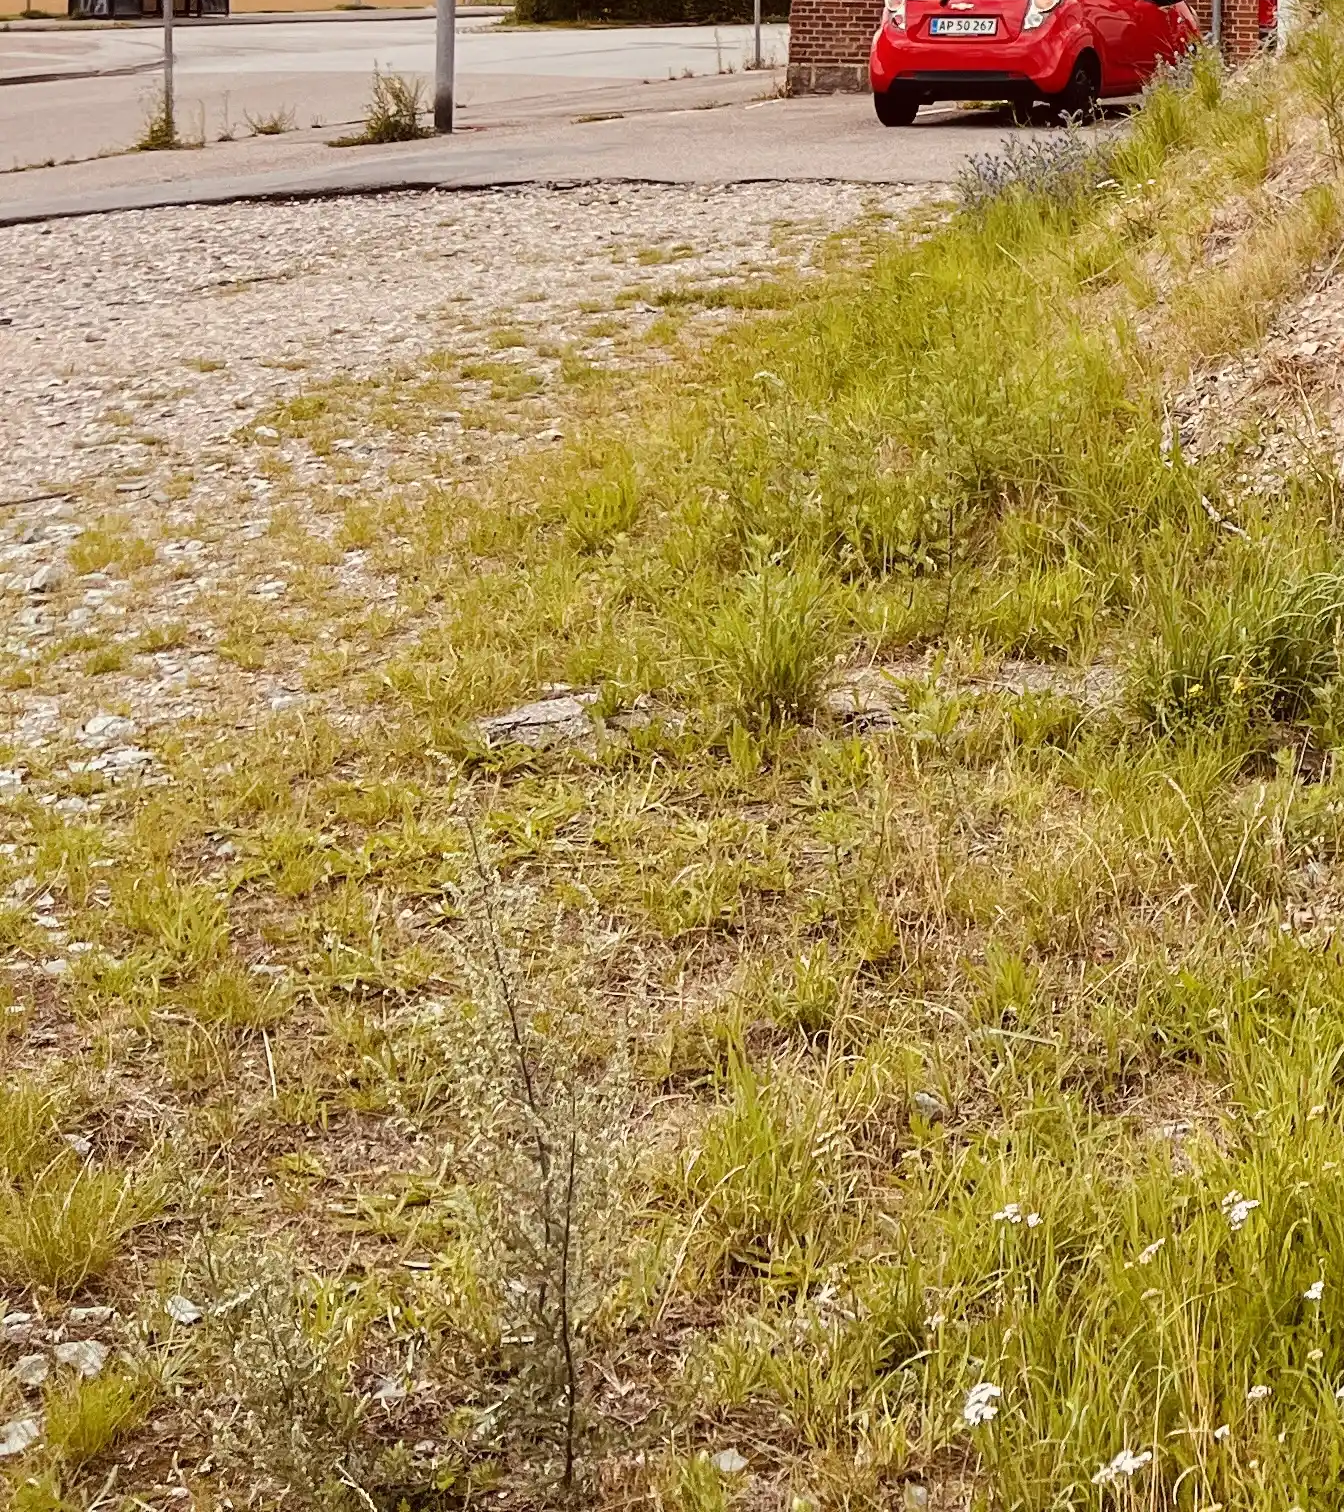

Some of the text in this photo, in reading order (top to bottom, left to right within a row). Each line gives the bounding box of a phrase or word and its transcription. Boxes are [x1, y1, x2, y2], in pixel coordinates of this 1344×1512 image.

[939, 20, 994, 31] AP 50 267
